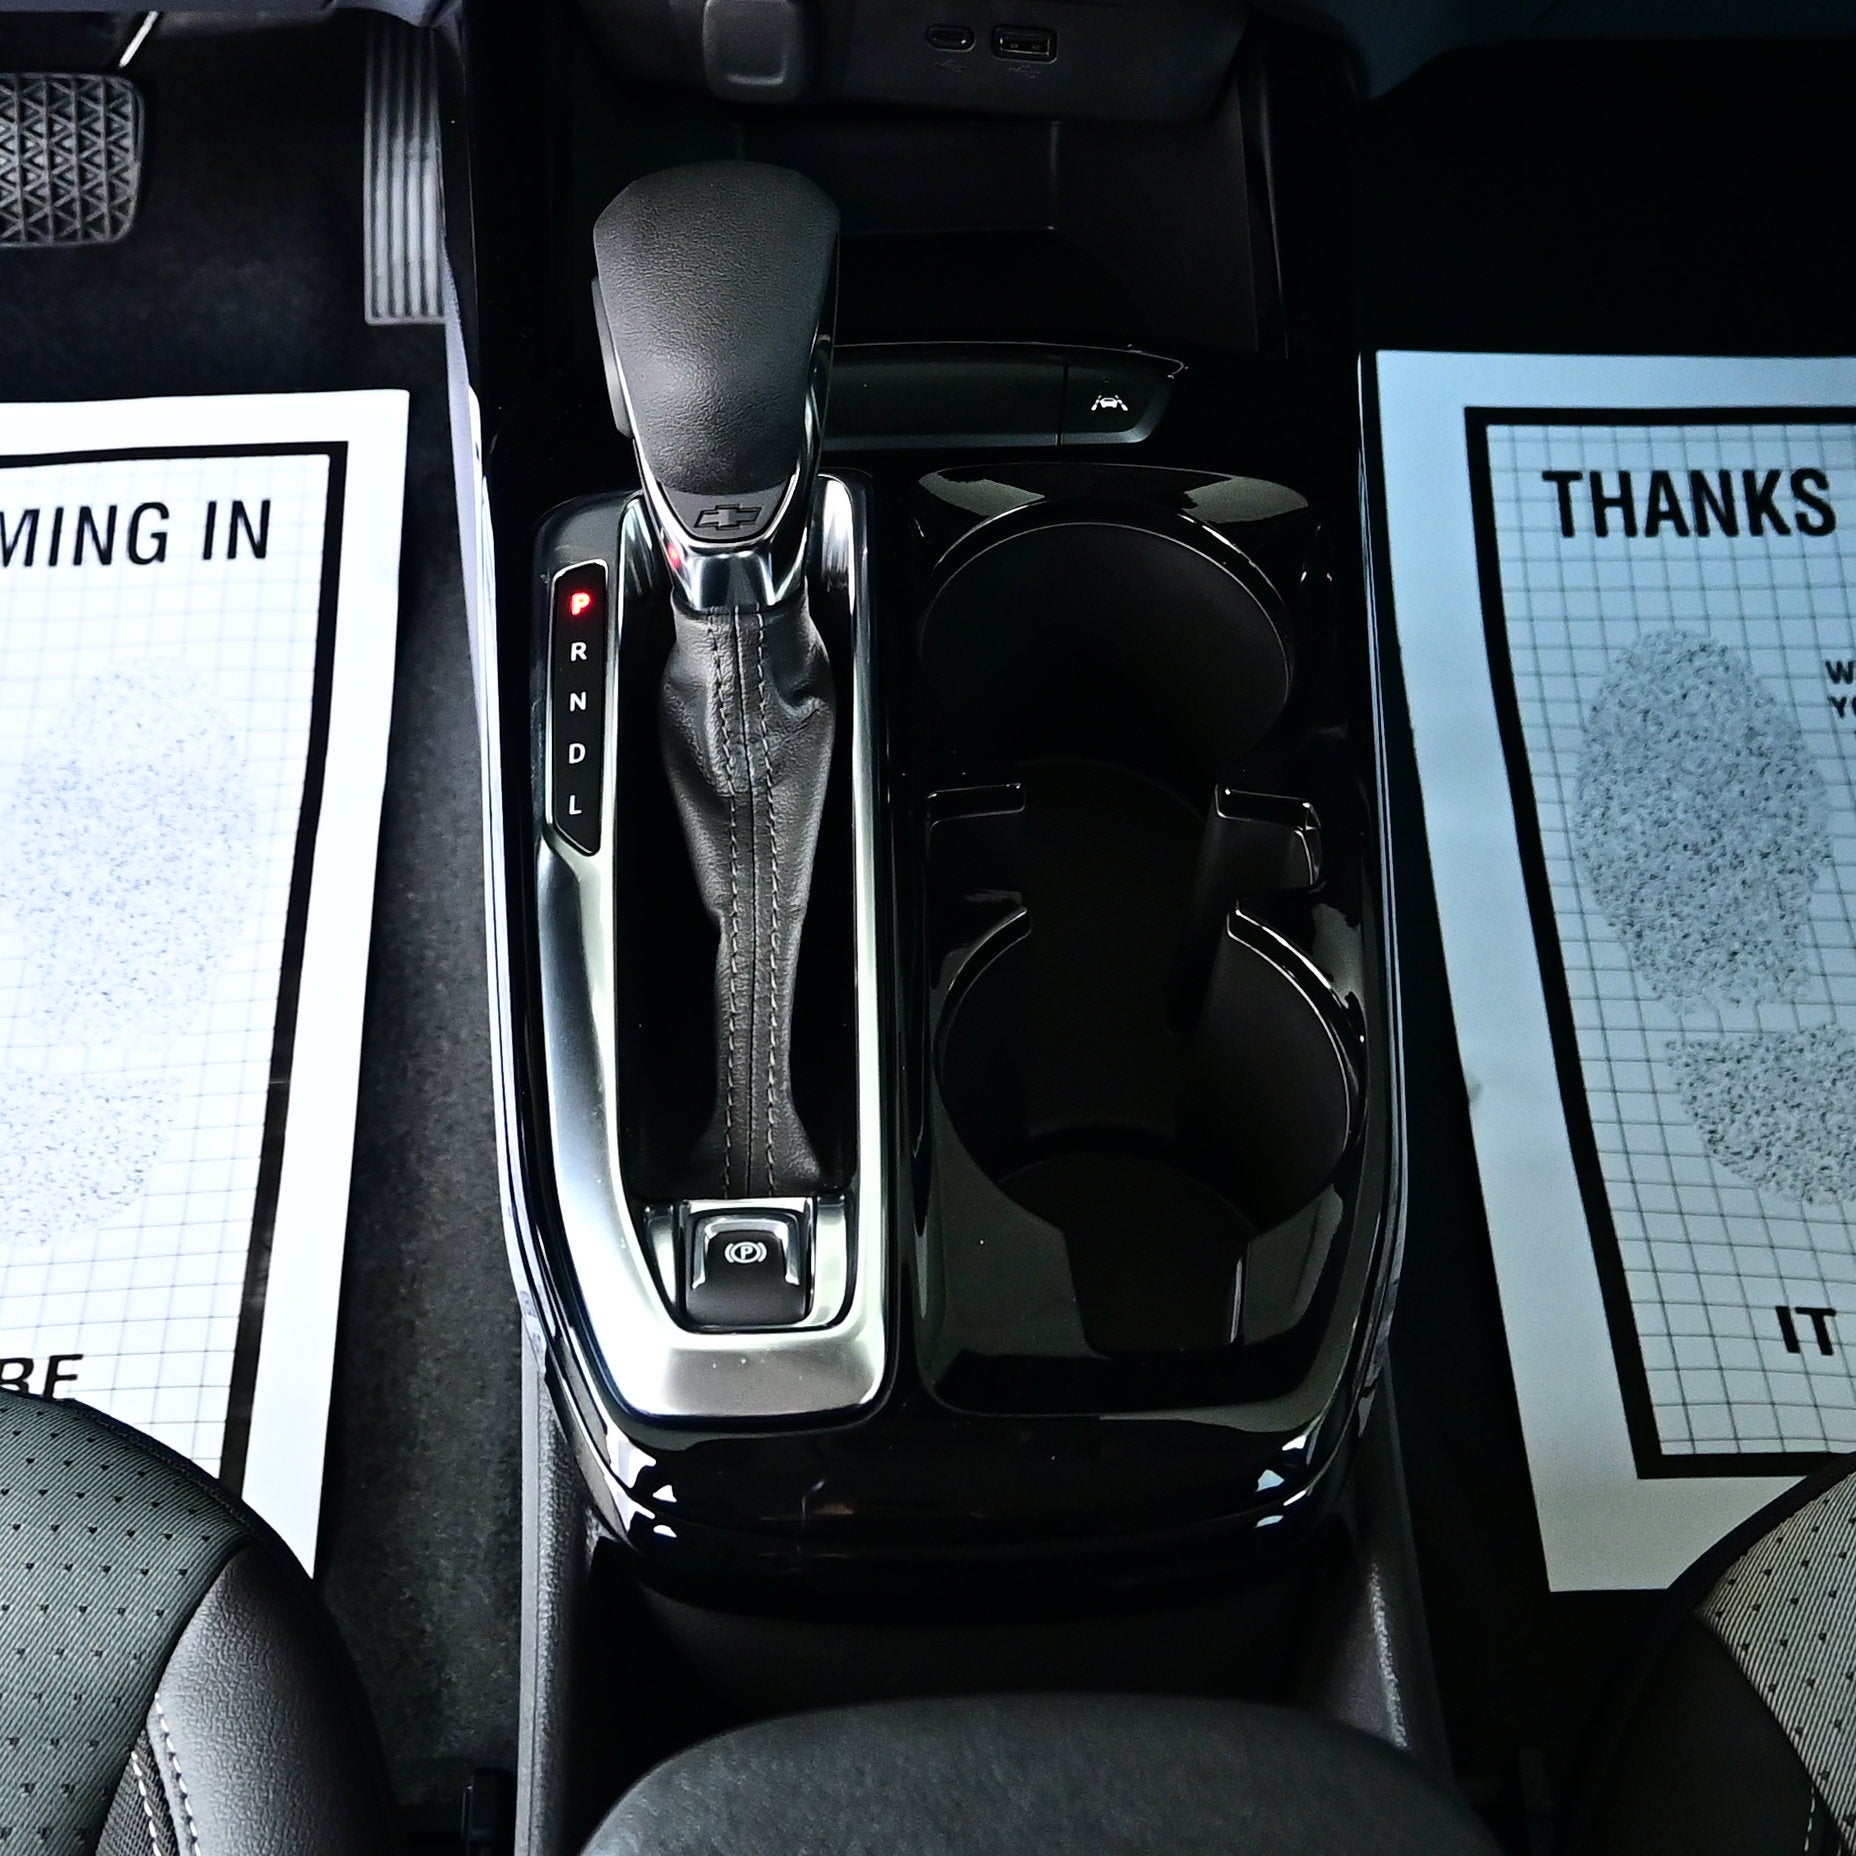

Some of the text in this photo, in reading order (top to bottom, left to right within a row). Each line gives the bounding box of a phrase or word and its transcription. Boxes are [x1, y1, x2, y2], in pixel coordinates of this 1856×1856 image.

[1542, 467, 1835, 539] THANKS
[203, 500, 270, 560] IN
[570, 592, 592, 615] P
[571, 642, 586, 661] R
[570, 692, 586, 711] N
[569, 743, 585, 763] D
[569, 795, 581, 814] L
[1773, 1304, 1837, 1355] IT
